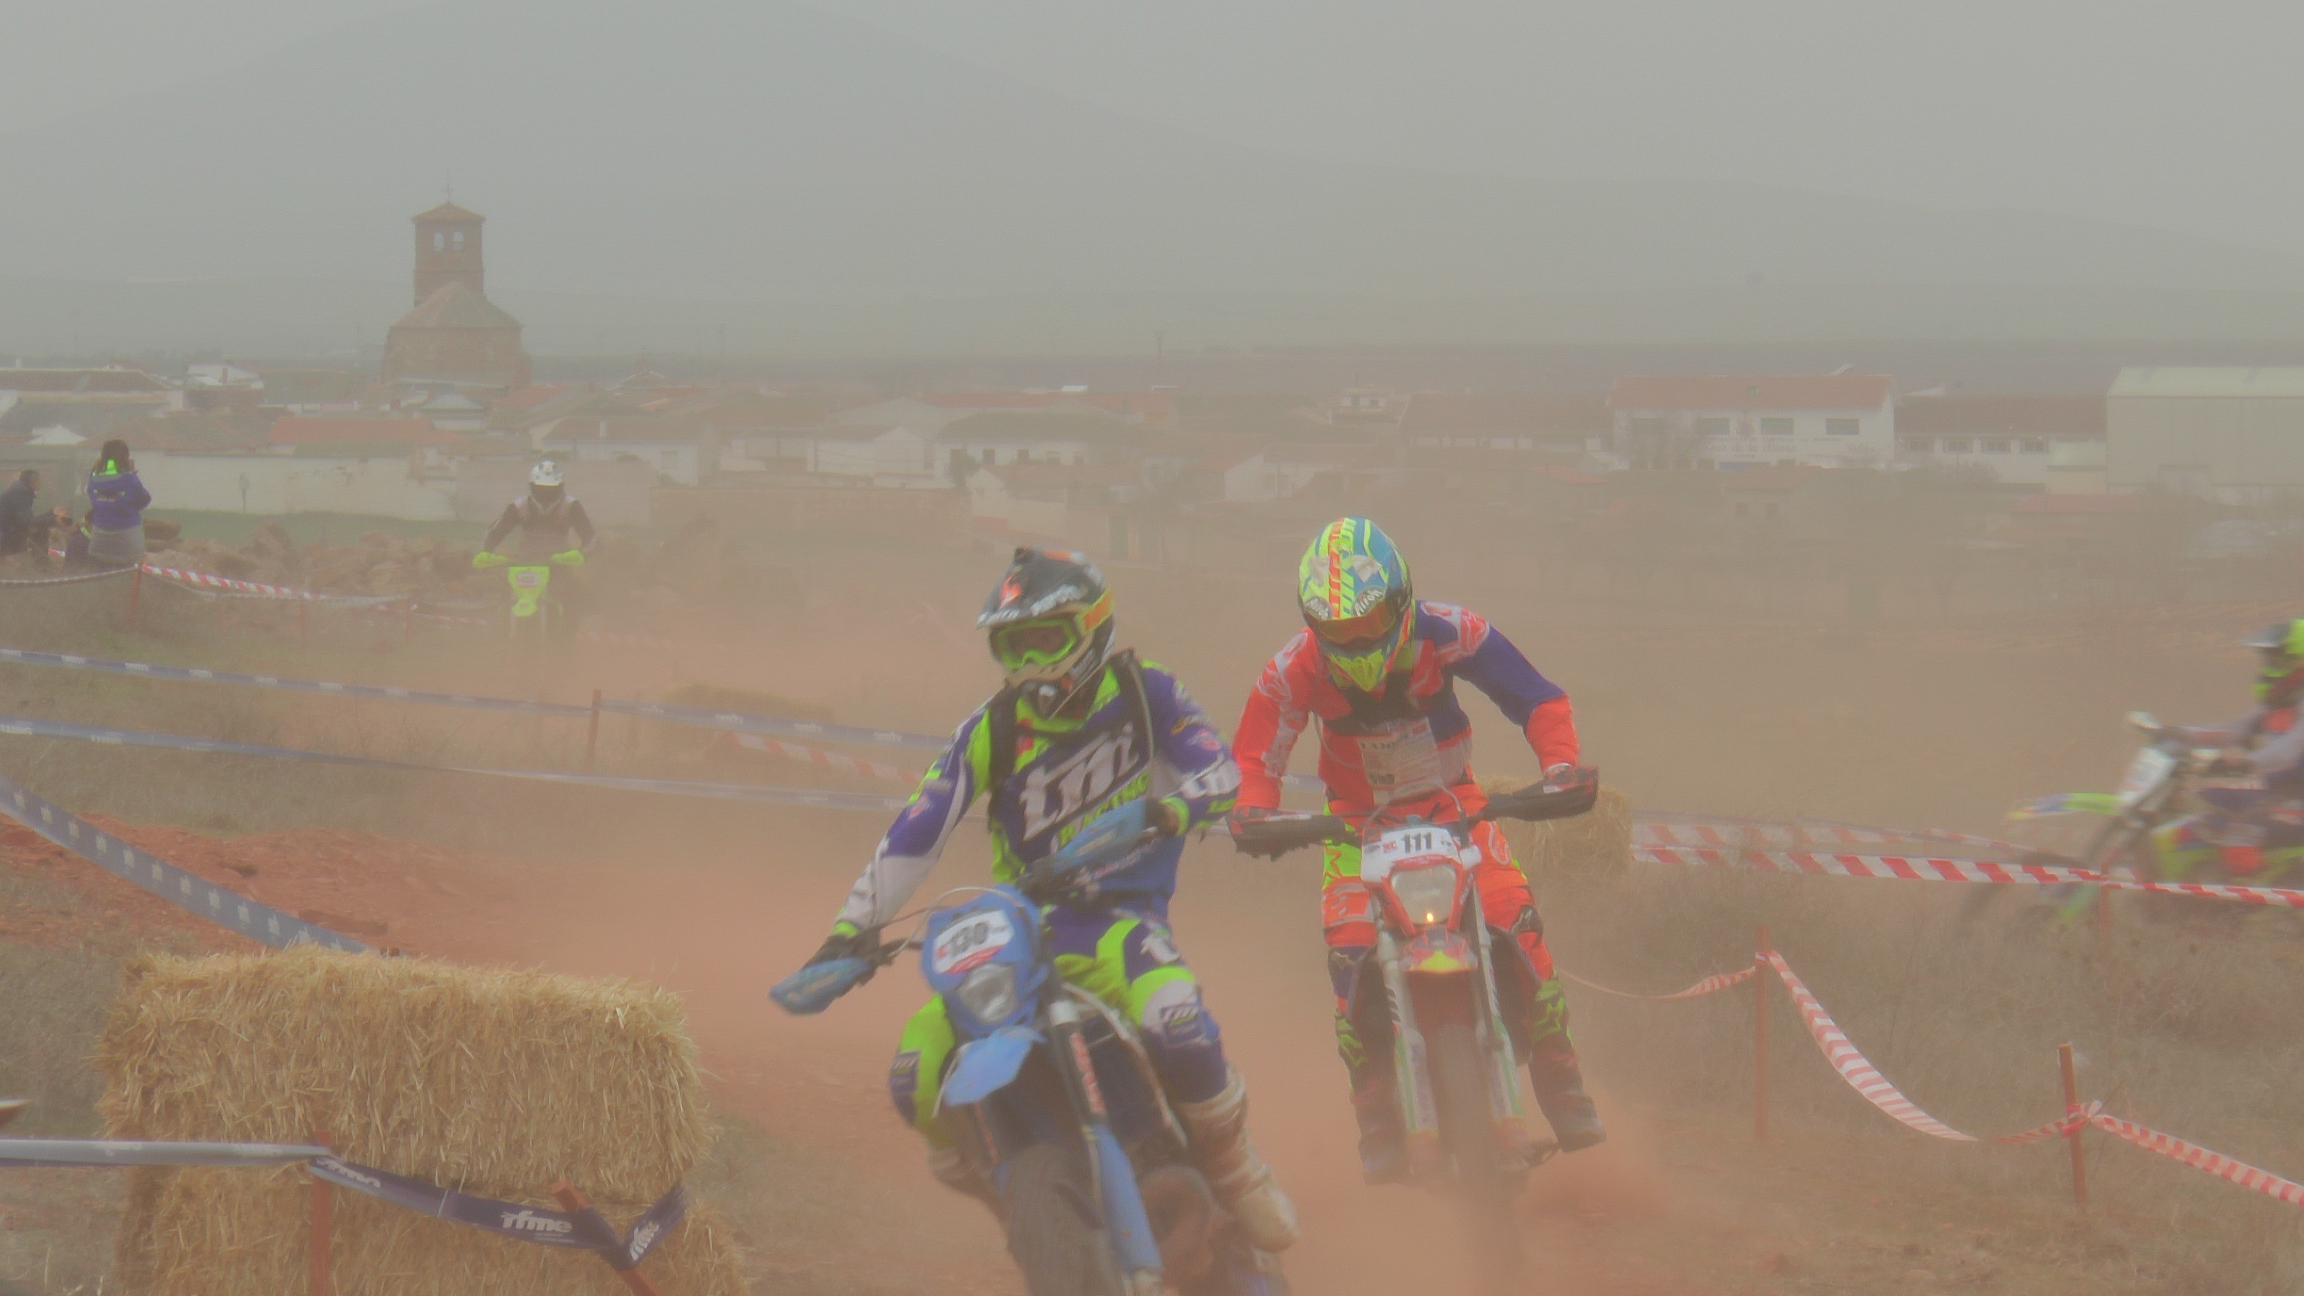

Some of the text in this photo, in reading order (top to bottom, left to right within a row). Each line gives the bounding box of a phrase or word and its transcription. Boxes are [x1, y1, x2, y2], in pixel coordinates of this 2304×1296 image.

[1401, 831, 1433, 854] 111
[949, 920, 989, 958] 130
[500, 1209, 573, 1234] rfme
